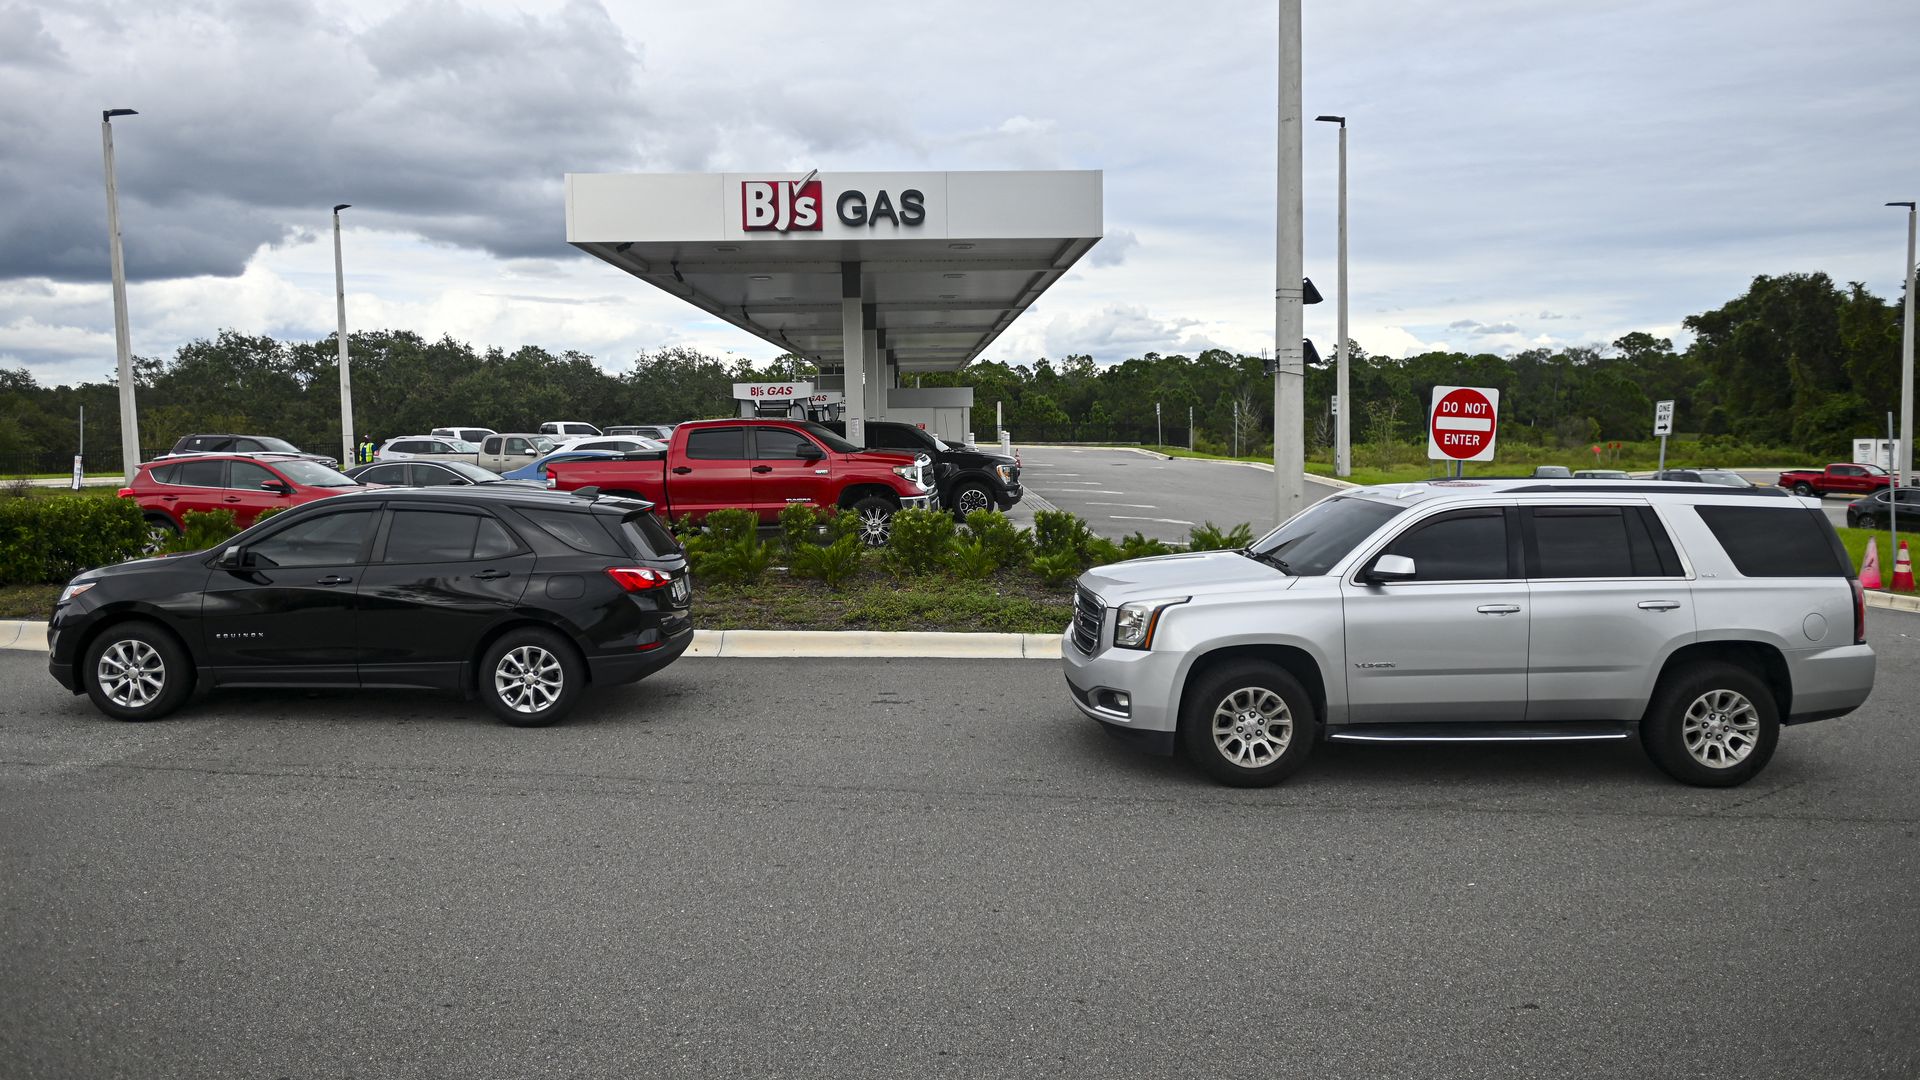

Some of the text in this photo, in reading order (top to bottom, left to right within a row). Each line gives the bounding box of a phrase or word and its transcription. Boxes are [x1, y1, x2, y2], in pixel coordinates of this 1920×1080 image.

[744, 169, 926, 231] BJ's GAS
[767, 386, 793, 396] GAS
[1443, 401, 1488, 415] DO NOT
[1659, 404, 1671, 412] ONE
[1443, 433, 1481, 446] ENTER
